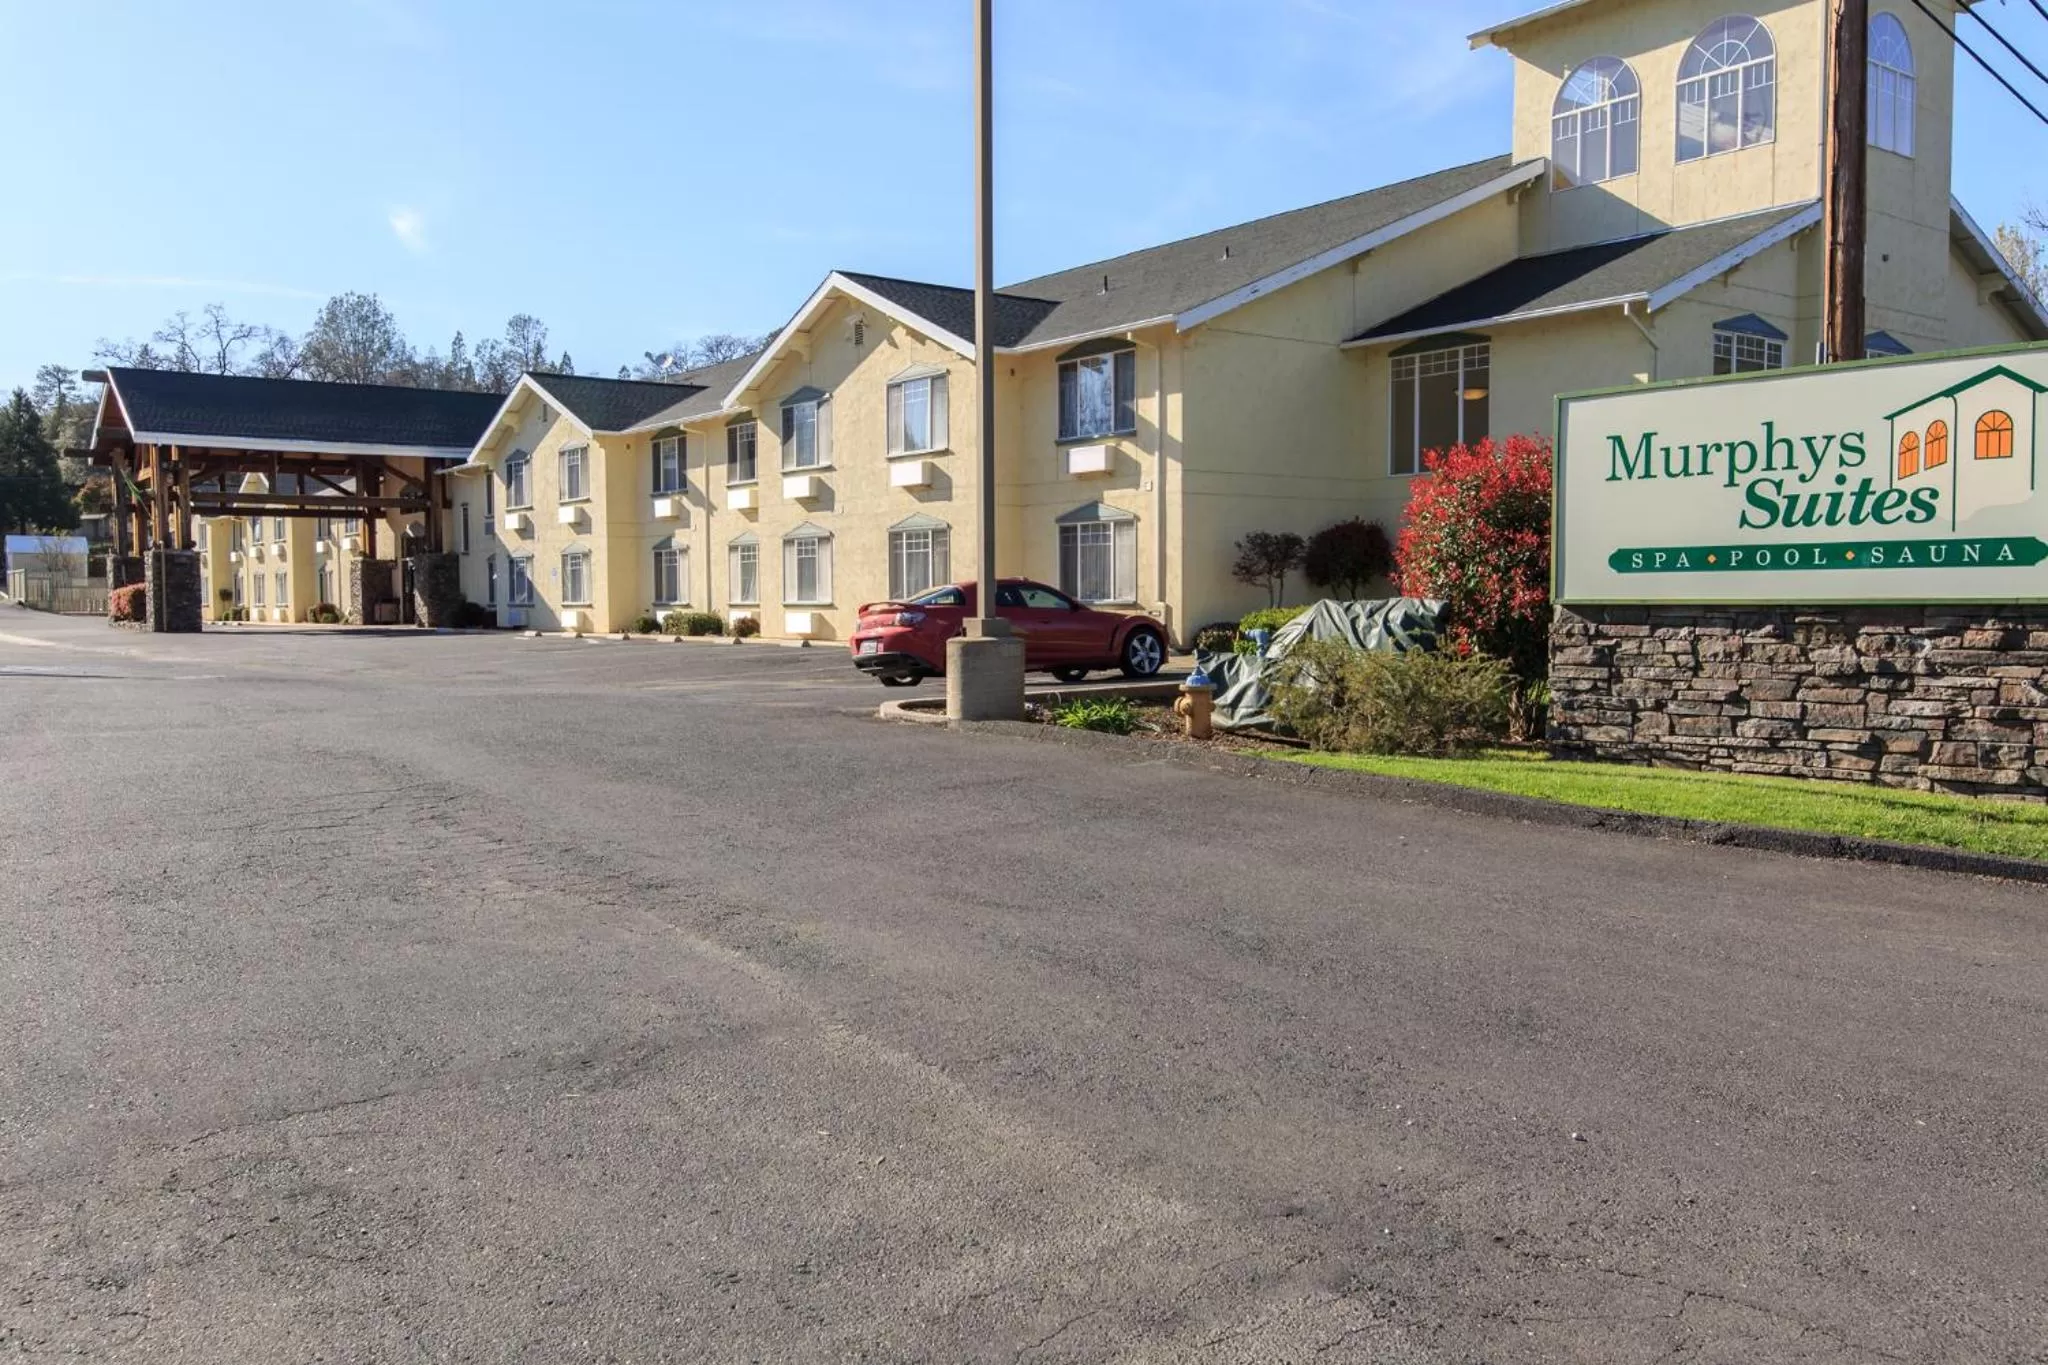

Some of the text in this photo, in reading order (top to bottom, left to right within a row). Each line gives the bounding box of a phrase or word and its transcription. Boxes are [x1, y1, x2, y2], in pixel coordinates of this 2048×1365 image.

[1605, 421, 1866, 488] Murphys
[1738, 473, 1940, 530] Suites
[1631, 543, 2016, 569] SPA POOL SAUNA
